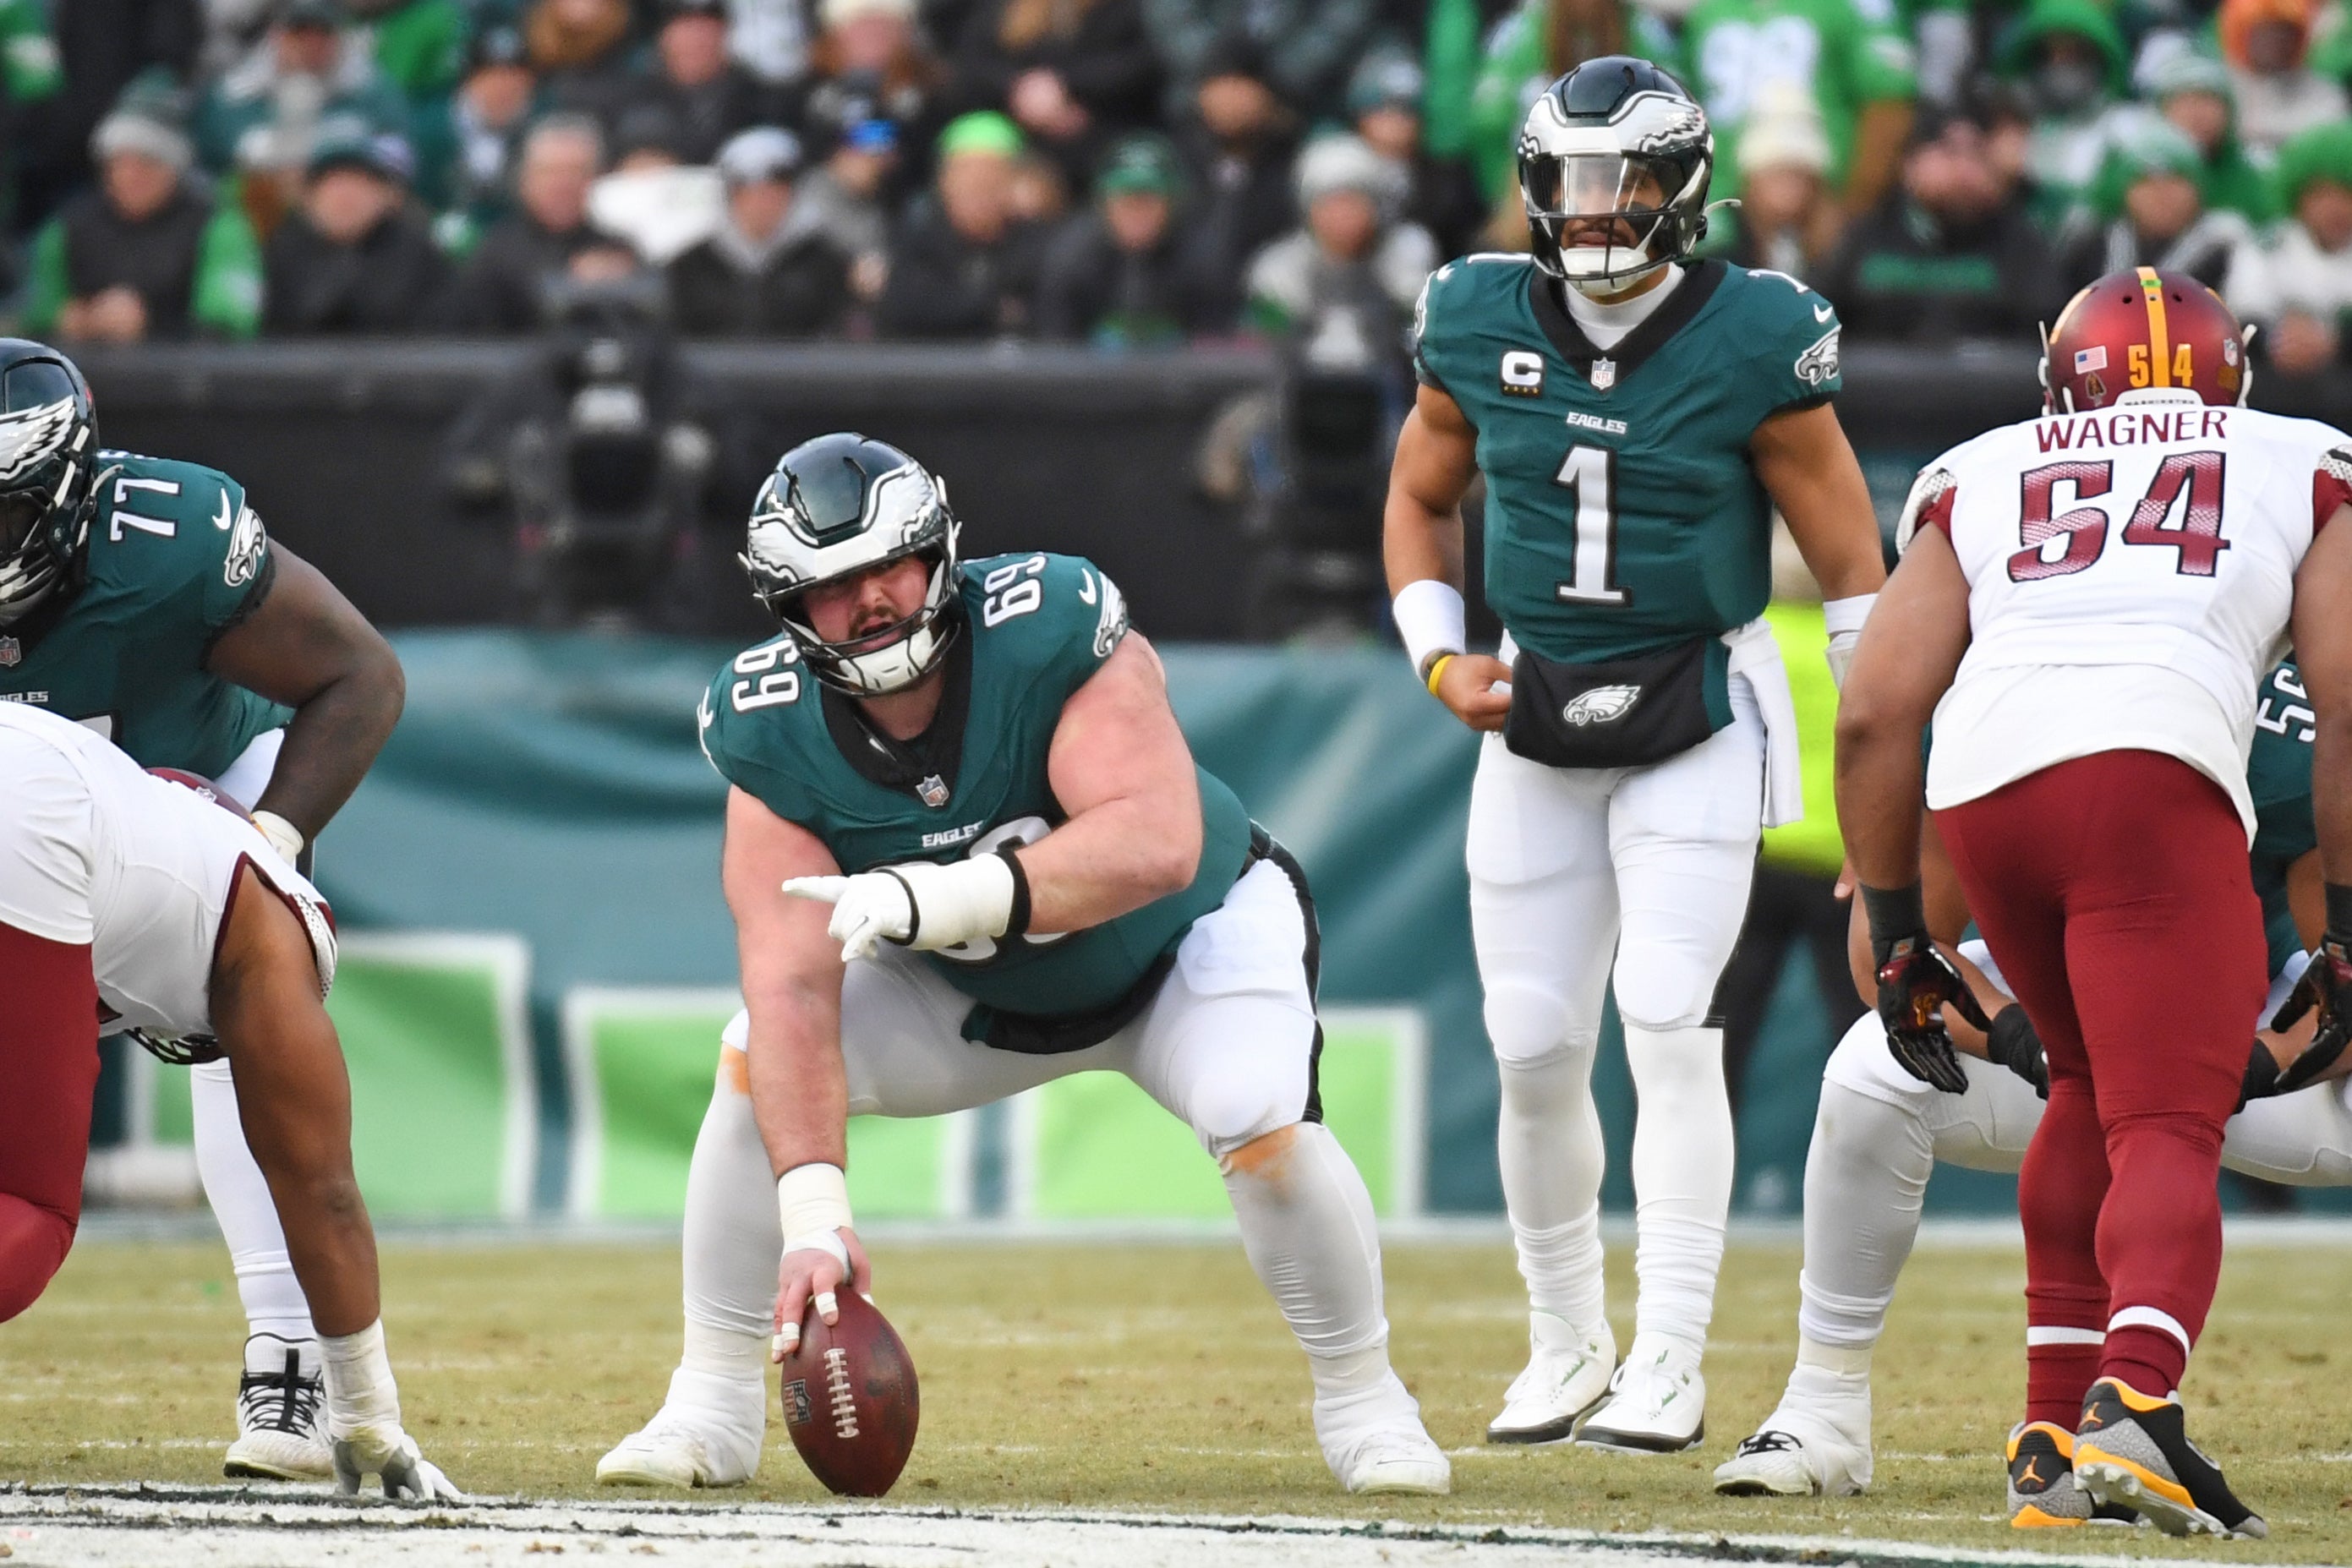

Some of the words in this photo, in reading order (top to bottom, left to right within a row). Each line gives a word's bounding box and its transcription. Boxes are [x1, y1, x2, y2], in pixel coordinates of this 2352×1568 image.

[1501, 350, 1544, 386] C
[1566, 412, 1628, 435] EAGLES
[2035, 410, 2228, 454] WAGNER
[109, 476, 182, 543] 77
[1554, 443, 1630, 604] 1
[2006, 450, 2232, 584] 54
[982, 554, 1047, 628] 69
[730, 636, 801, 713] 69
